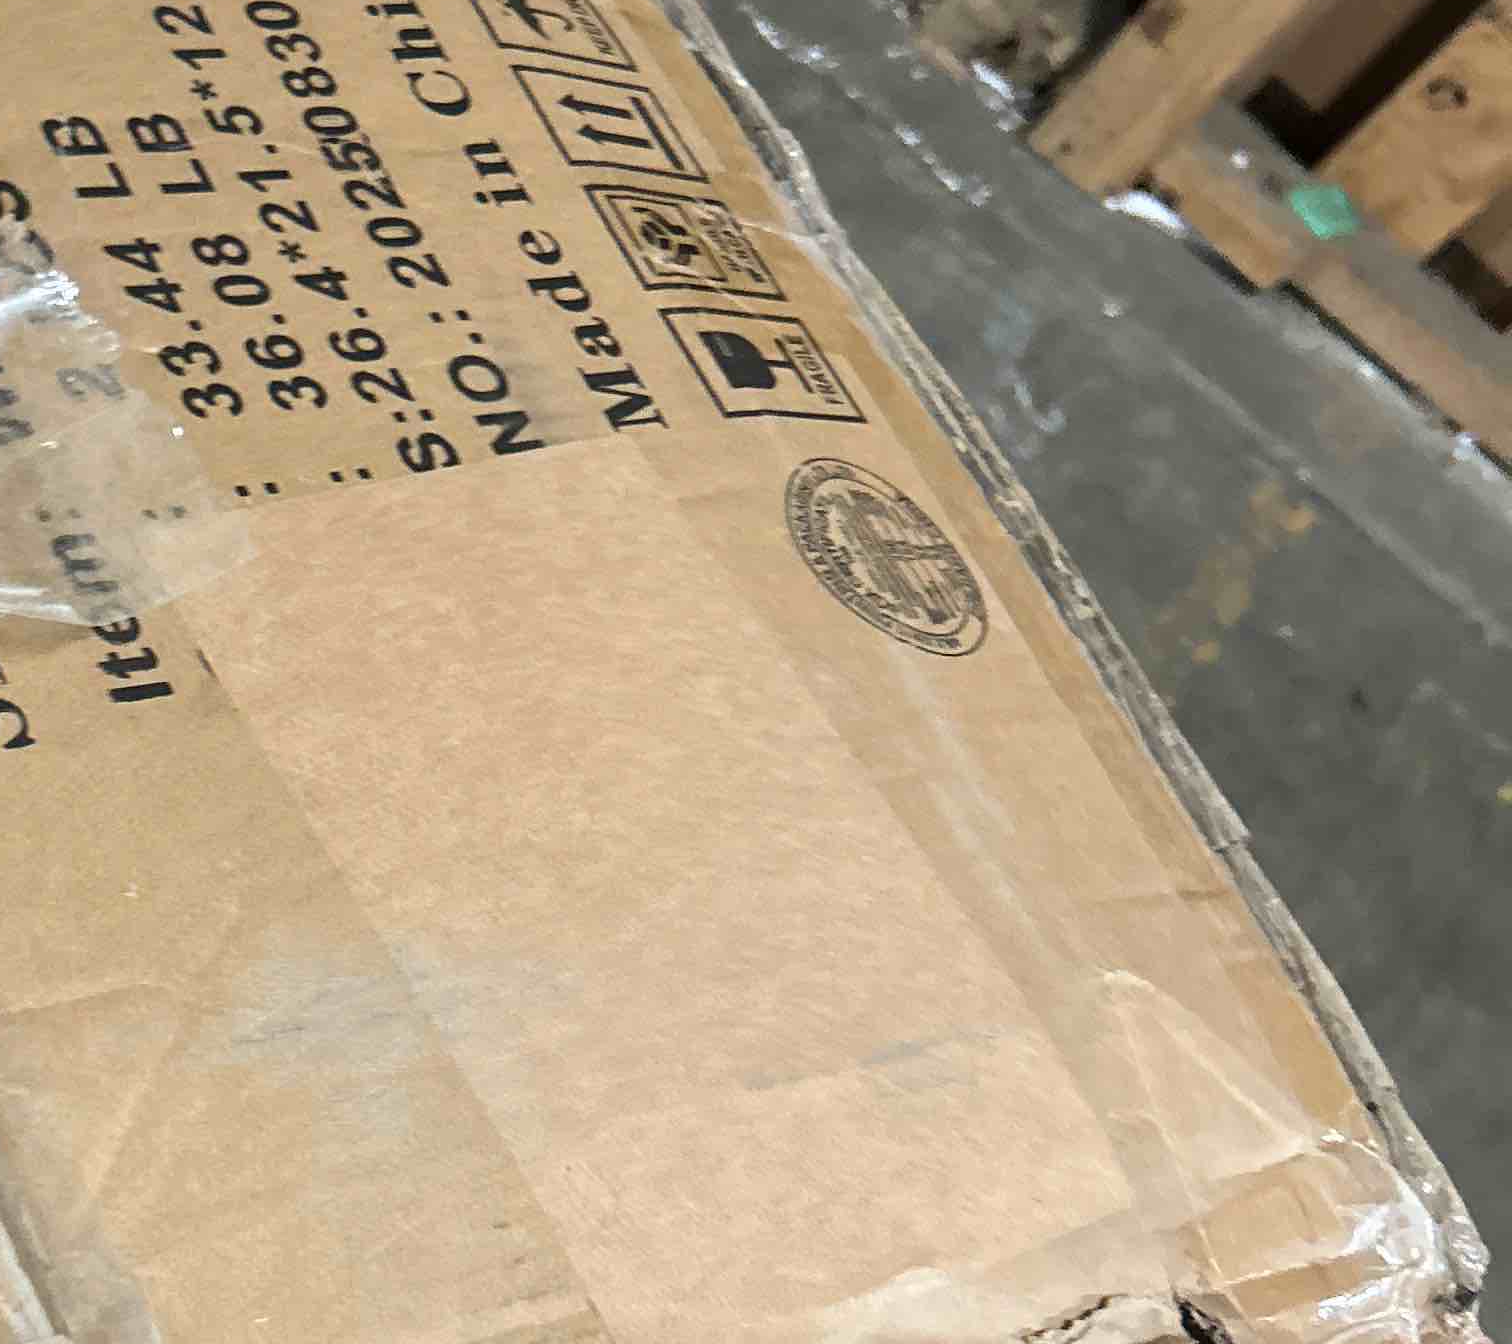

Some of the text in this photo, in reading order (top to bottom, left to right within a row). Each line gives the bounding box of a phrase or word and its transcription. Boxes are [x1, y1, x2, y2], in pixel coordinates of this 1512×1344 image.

[41, 116, 245, 420] 33.44 LB
[126, 112, 329, 411] 36.08 LB
[246, 0, 452, 289] 20250830
[462, 138, 535, 207] in
[428, 309, 548, 456] NO.:
[517, 228, 671, 433] Made
